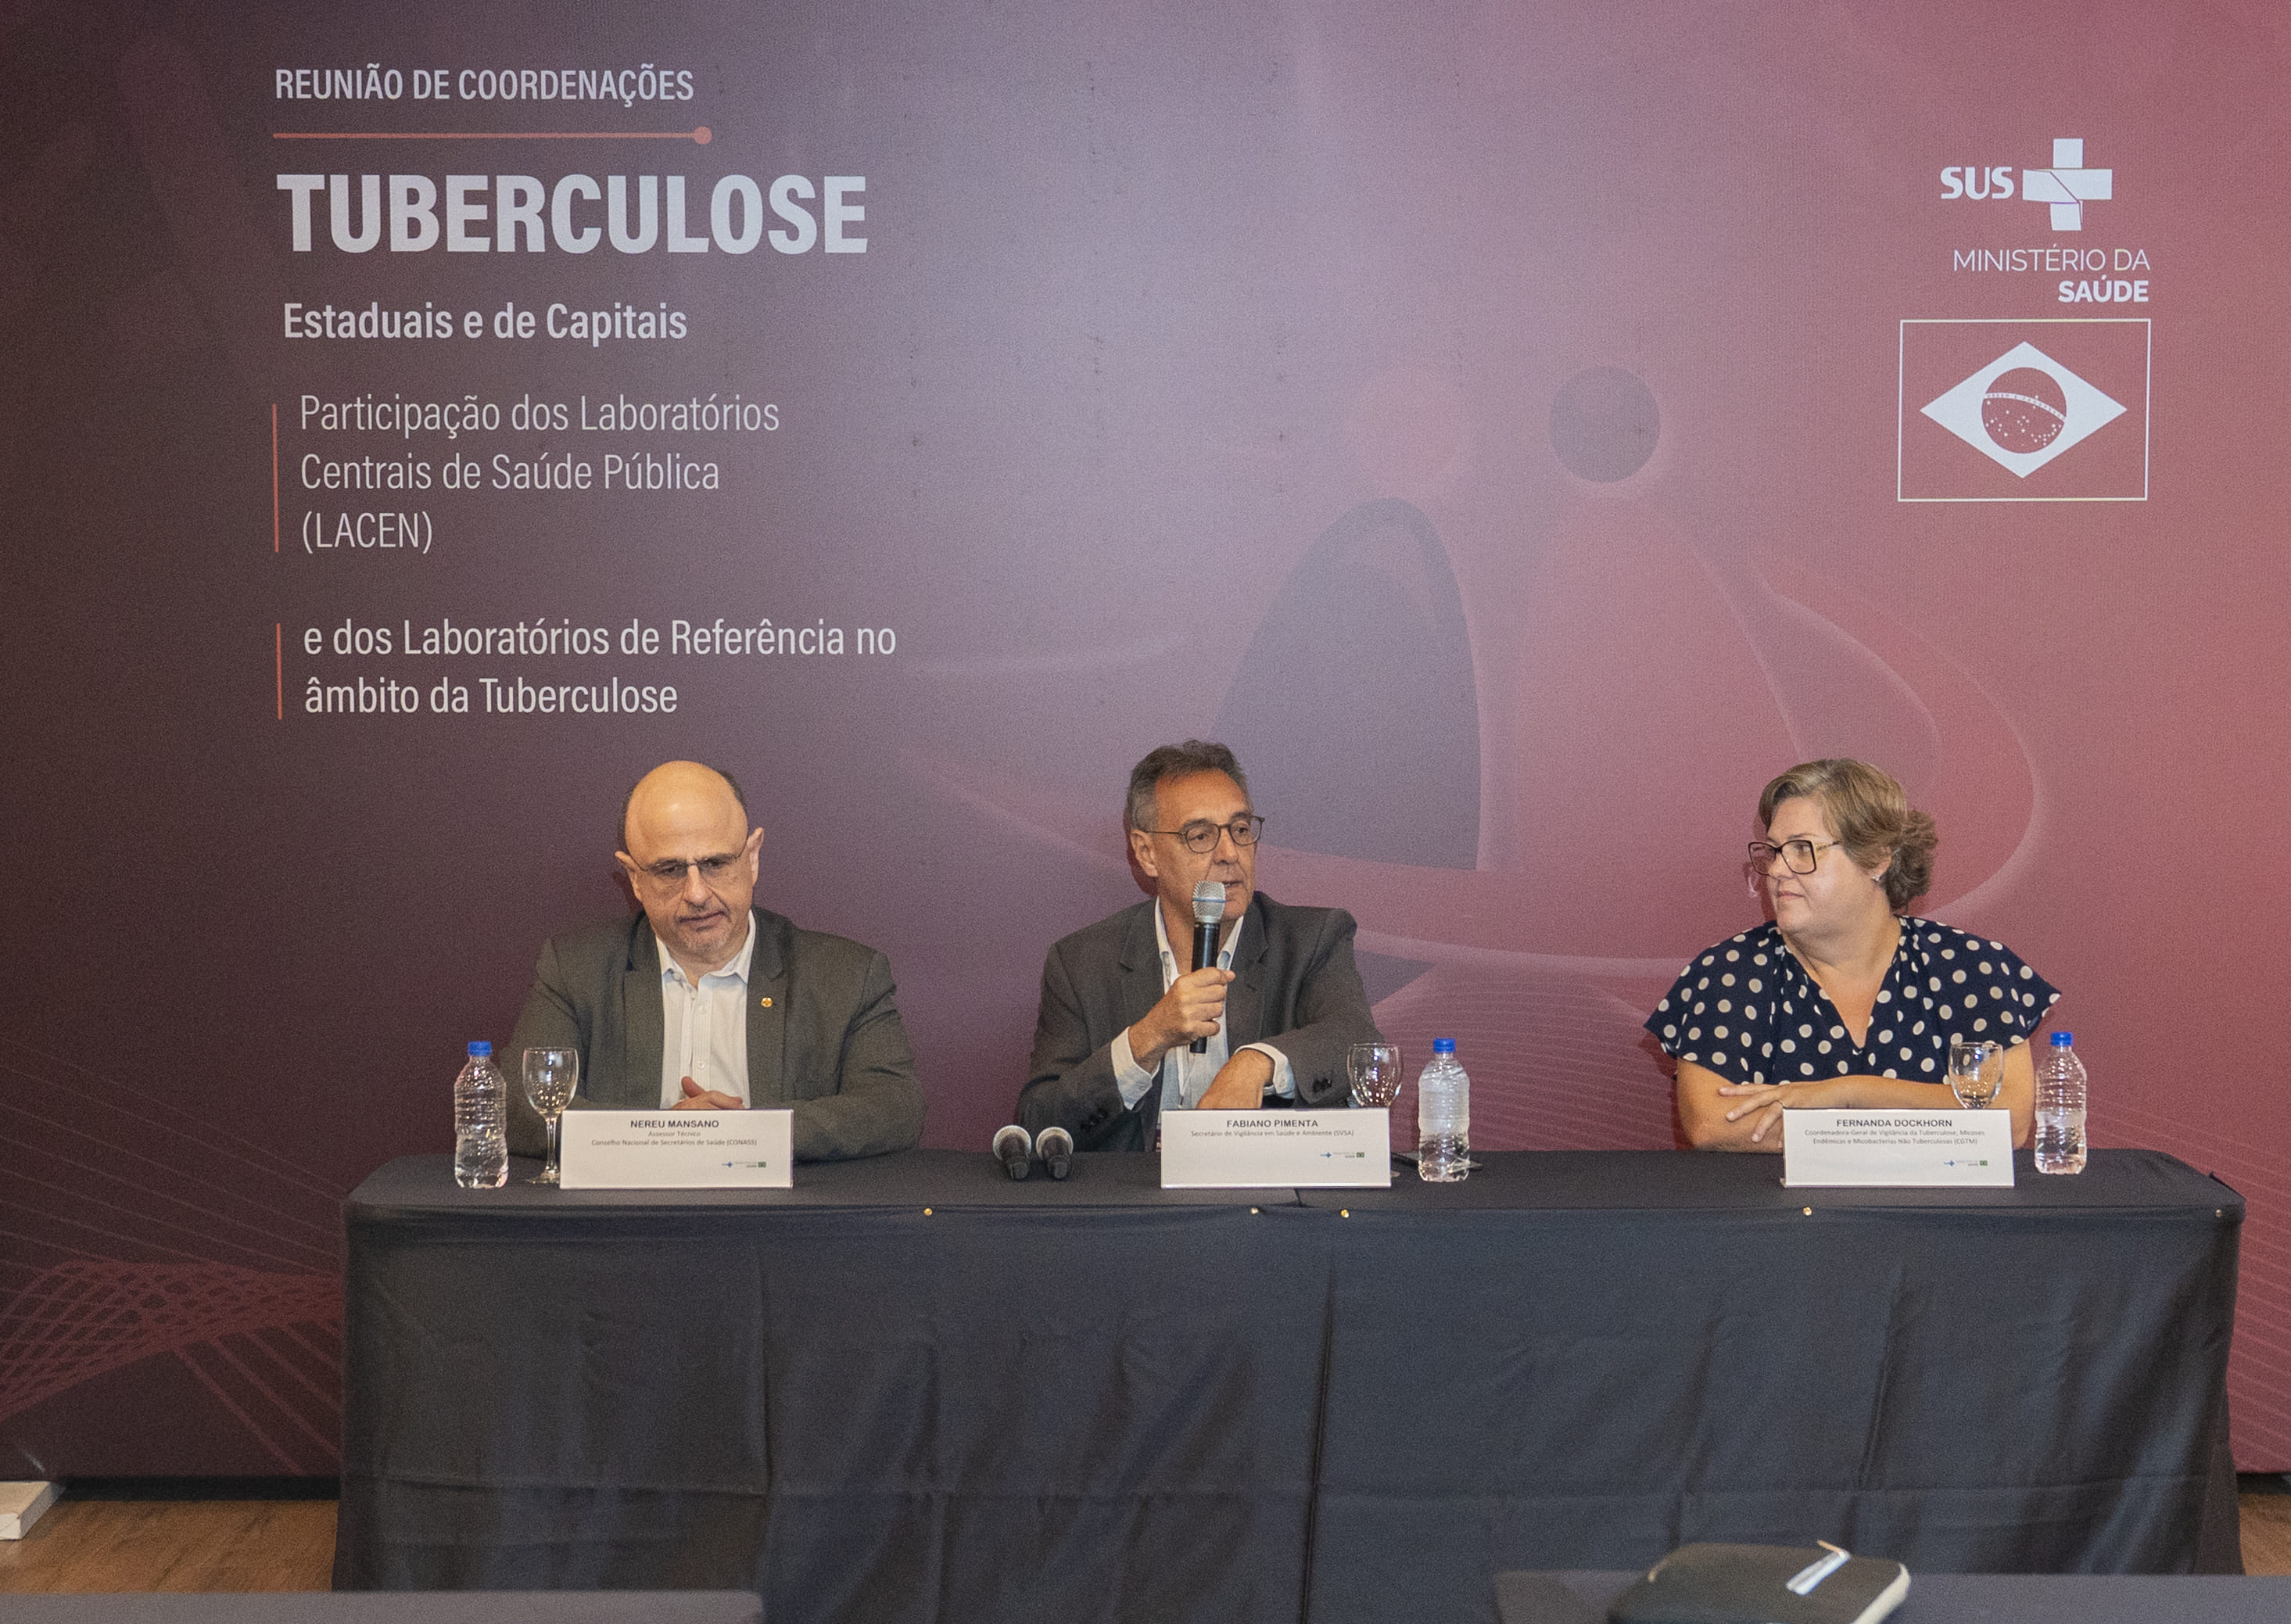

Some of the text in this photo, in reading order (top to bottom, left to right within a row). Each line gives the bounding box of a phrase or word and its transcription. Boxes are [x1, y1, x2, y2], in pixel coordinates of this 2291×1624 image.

[275, 63, 694, 108] REUNIÃO DE COORDENAÇÕES
[1940, 166, 2015, 201] SUS
[276, 174, 868, 255] TUBERCULOSE
[1952, 242, 2151, 272] MINISTÉRIO DA
[2057, 274, 2149, 303] SAÚDE
[284, 301, 687, 348] Estaduais e de Capitais
[300, 393, 780, 440] Participação dos Laboratórios
[300, 451, 719, 490] Centrais de Saúde Pública
[302, 510, 433, 554] (LACEN)
[303, 617, 896, 655] e dos Laboratórios de Referência no
[304, 676, 678, 714] âmbito da Tuberculose
[630, 1120, 719, 1128] NEREU MANSANO
[1226, 1119, 1319, 1128] FABIANO PIMENTA
[1836, 1119, 1952, 1127] FERNANDA DOCKHORN
